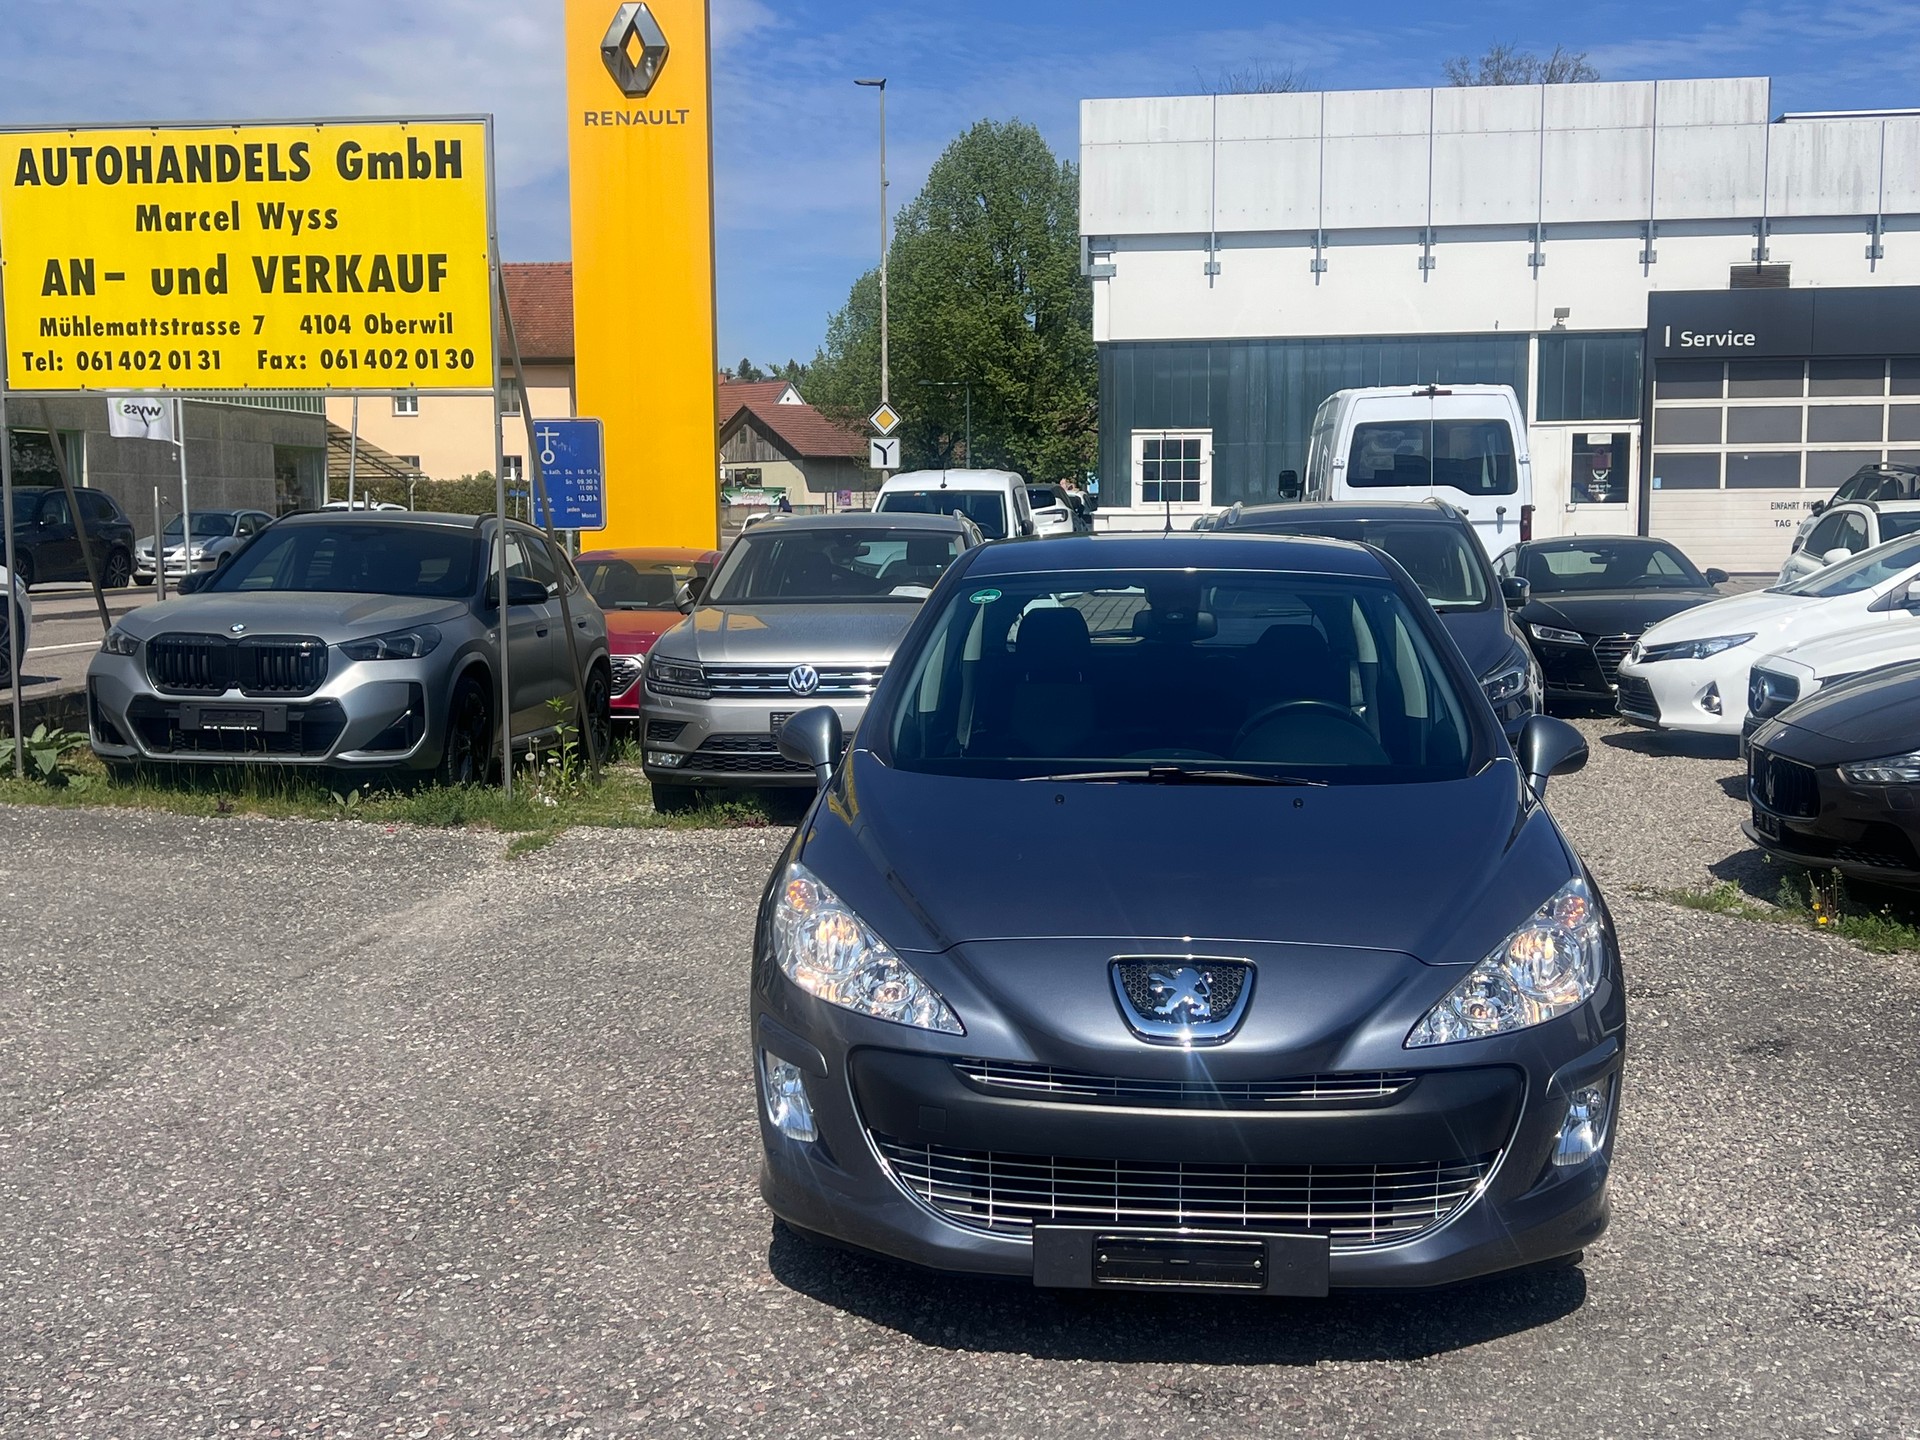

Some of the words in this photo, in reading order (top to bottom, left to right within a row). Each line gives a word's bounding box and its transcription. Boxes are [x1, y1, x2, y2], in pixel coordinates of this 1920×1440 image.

[584, 110, 690, 127] RENAULT
[14, 142, 312, 186] AUTOHANDELS
[336, 136, 462, 181] GmbH
[136, 201, 240, 232] Marcel
[256, 202, 338, 236] Wyss
[151, 253, 228, 296] und
[252, 253, 448, 293] VERKAUF
[39, 315, 241, 337] Mühlemattstrasse
[253, 315, 265, 334] 7
[300, 314, 351, 334] 4104
[364, 312, 453, 334] Oberwil
[1680, 329, 1757, 348] Service
[22, 350, 63, 371] Tel:
[257, 349, 307, 370] Fax:
[1770, 501, 1800, 510] EINFAHRT
[1774, 519, 1791, 528] TAG
